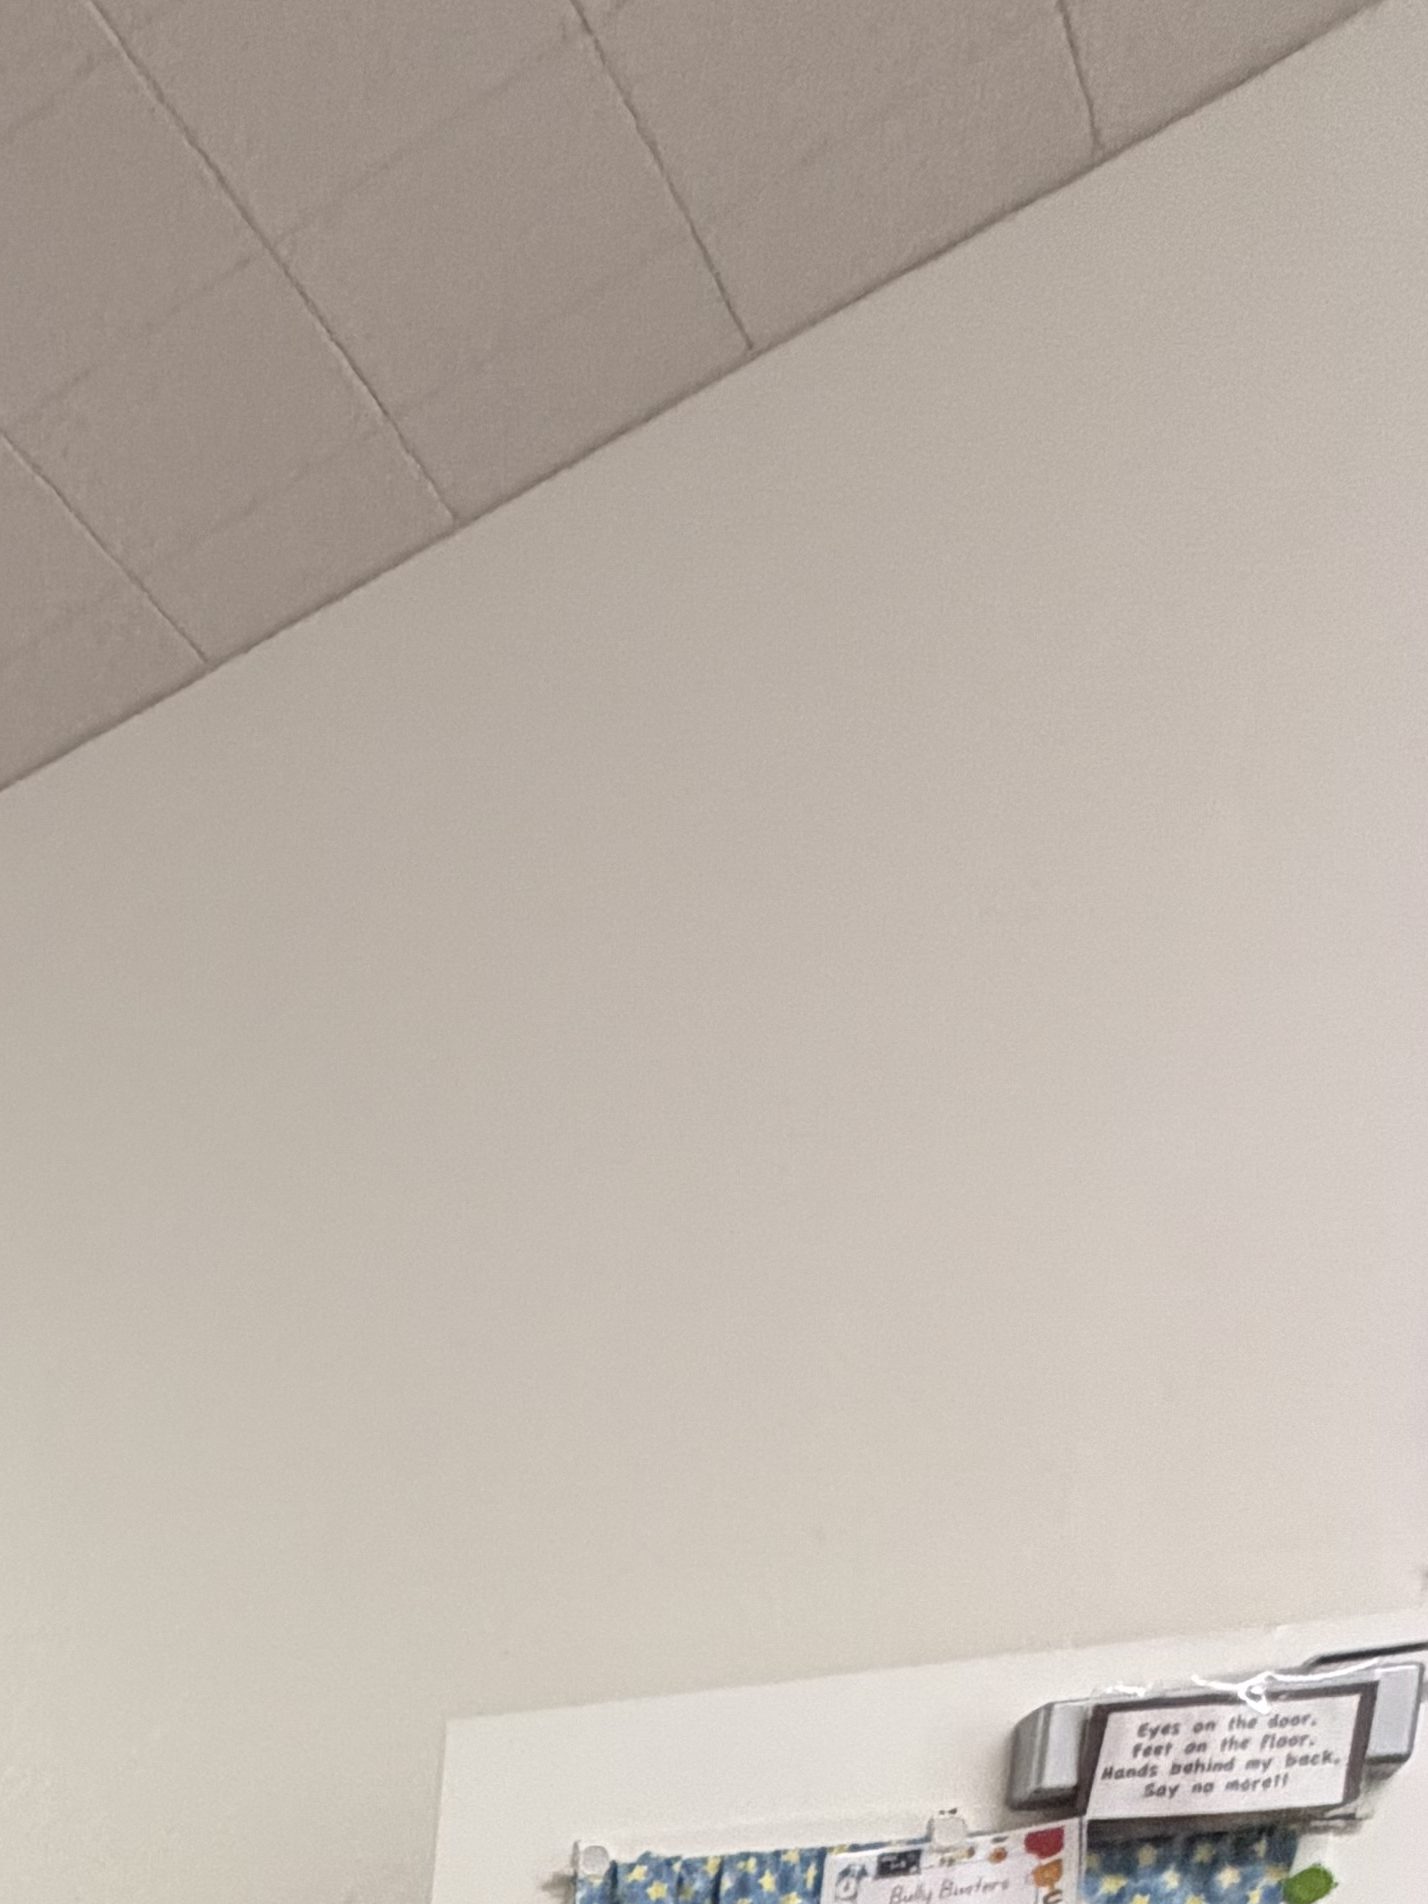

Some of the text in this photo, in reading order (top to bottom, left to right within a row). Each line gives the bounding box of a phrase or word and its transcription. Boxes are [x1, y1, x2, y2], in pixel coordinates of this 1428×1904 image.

[1137, 1713, 1317, 1740] Eyes on the door.
[1184, 1741, 1207, 1755] on
[1220, 1735, 1253, 1752] the
[1260, 1732, 1315, 1751] floor.
[1101, 1750, 1341, 1781] Hands behind my back.
[1144, 1782, 1180, 1800] Say
[1192, 1781, 1214, 1794] no
[938, 1877, 1010, 1899] Busters
